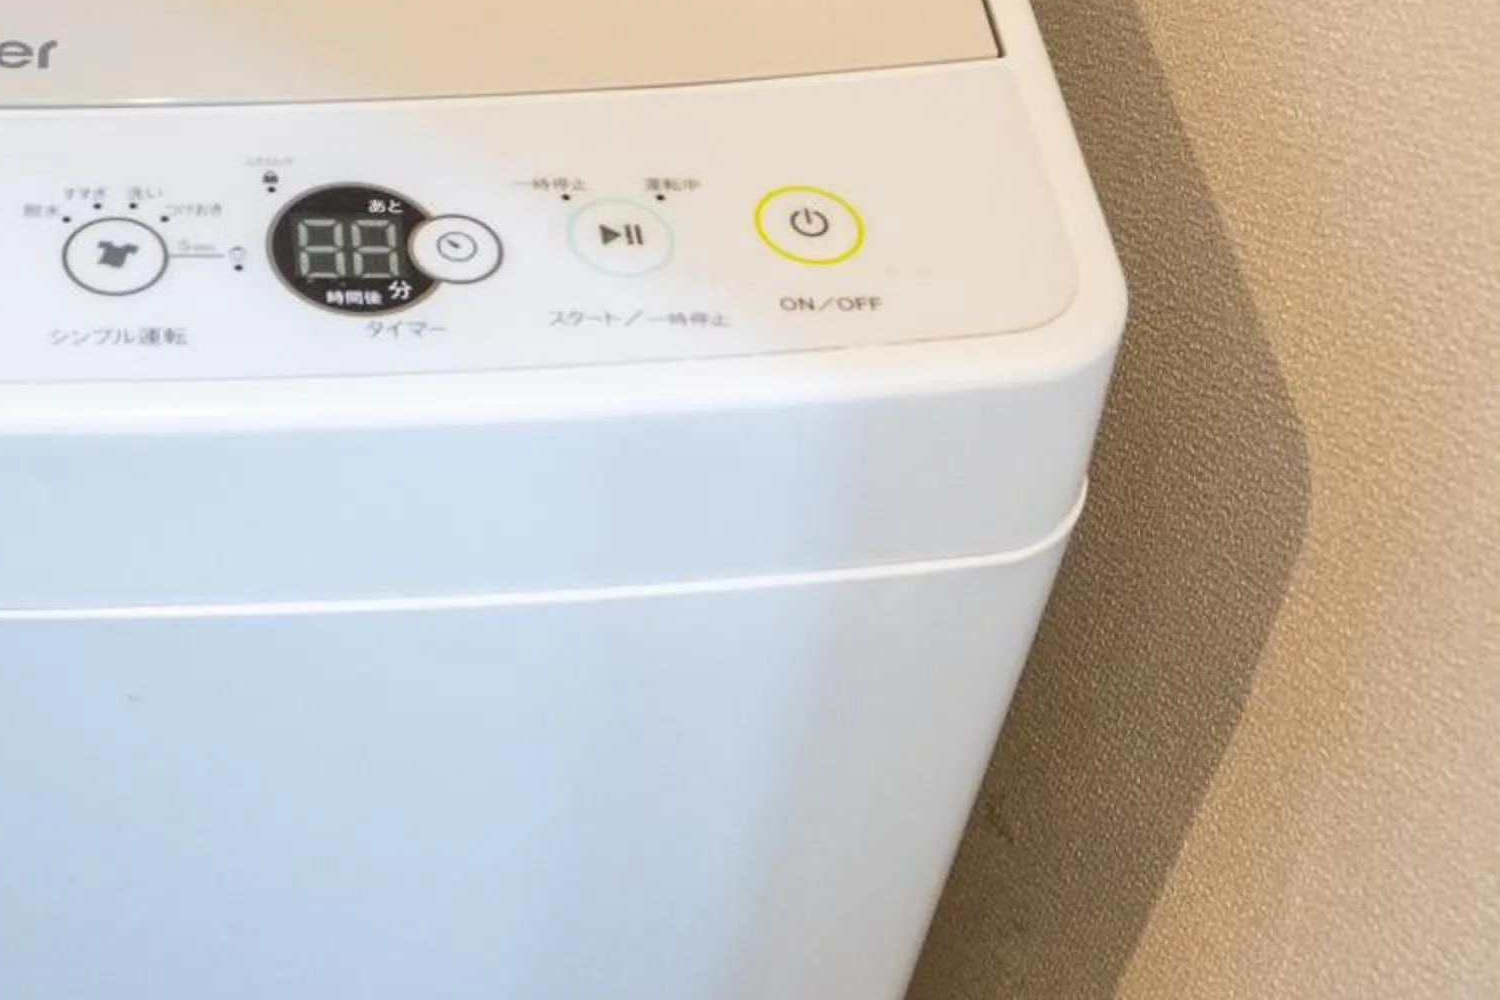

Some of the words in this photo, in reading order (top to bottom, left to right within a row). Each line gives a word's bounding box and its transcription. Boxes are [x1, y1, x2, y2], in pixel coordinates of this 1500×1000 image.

[368, 200, 403, 213] あと
[326, 290, 382, 305] 時間後
[389, 281, 412, 300] 分
[780, 297, 883, 312] ON/OFF
[50, 328, 188, 346] シンプル運転
[365, 321, 446, 338] タイマー
